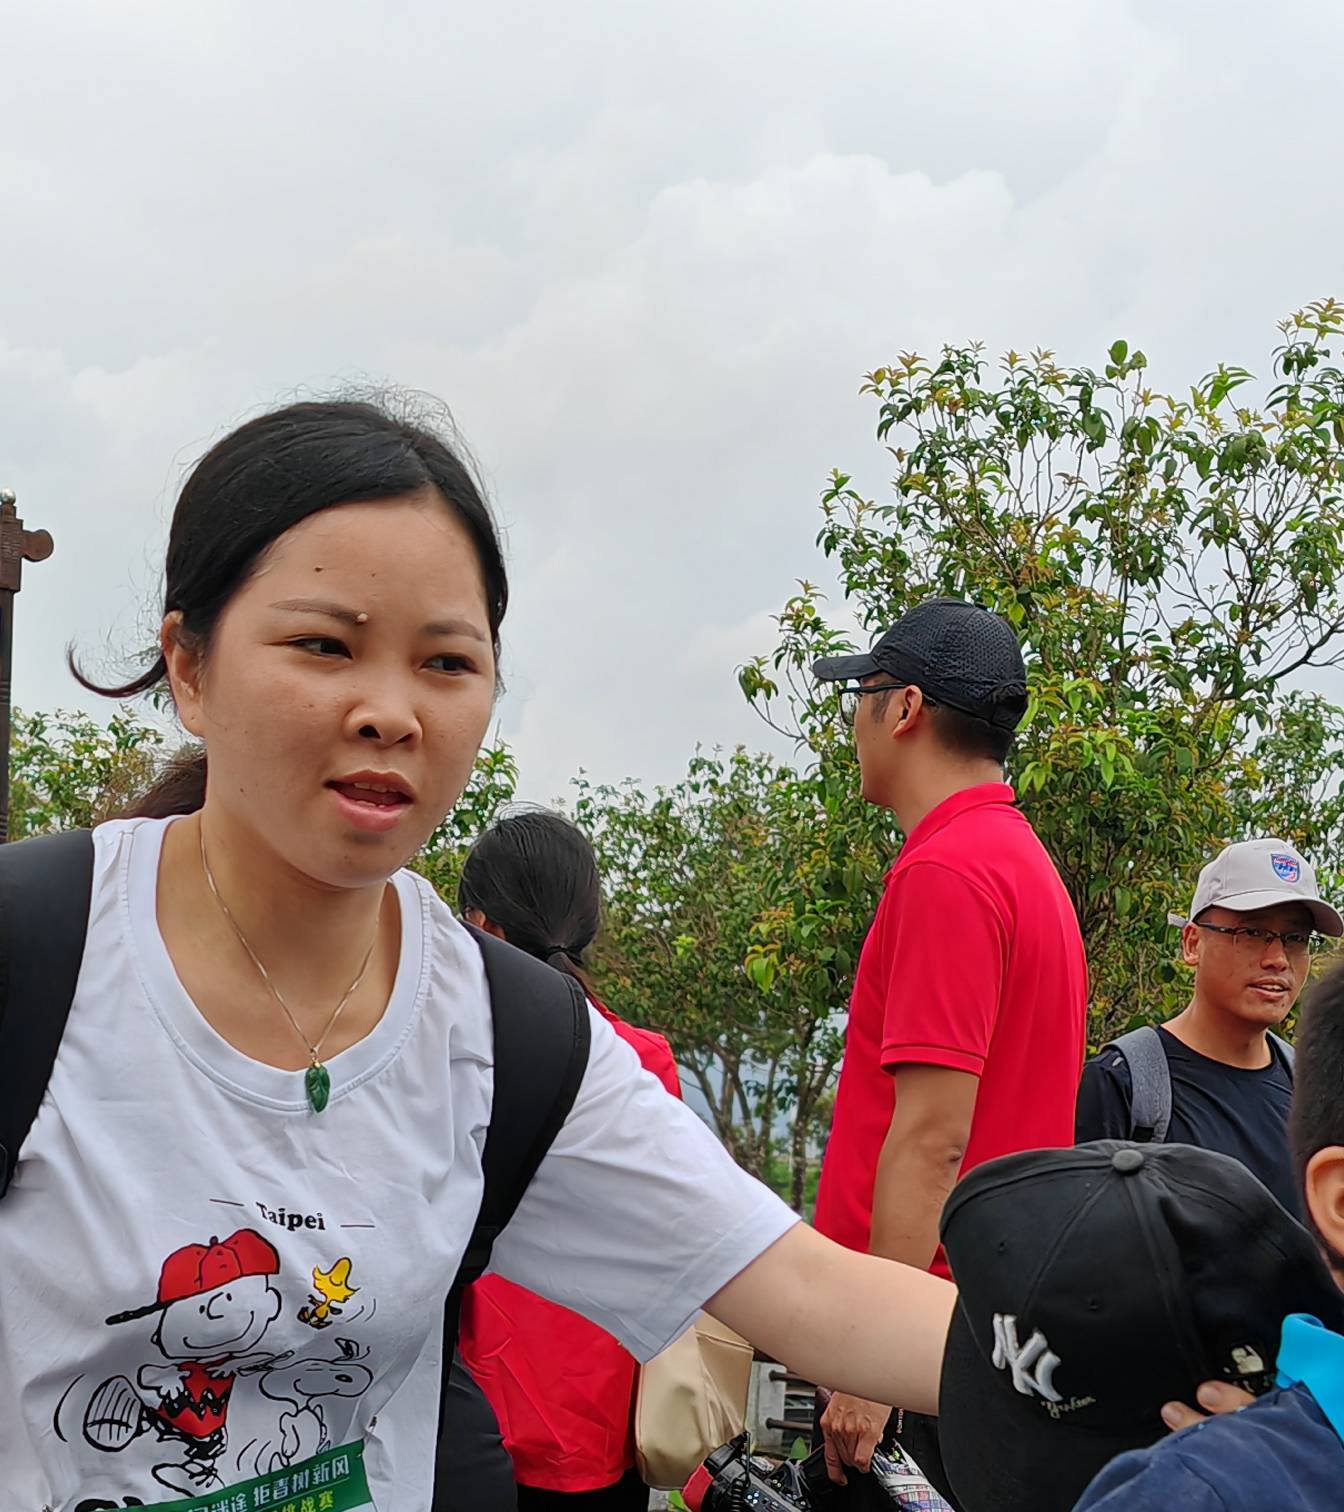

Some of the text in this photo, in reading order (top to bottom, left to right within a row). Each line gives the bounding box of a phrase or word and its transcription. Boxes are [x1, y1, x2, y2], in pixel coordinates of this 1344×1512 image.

[256, 1202, 327, 1232] Taipei
[252, 1454, 351, 1506] 拒毒树新风
